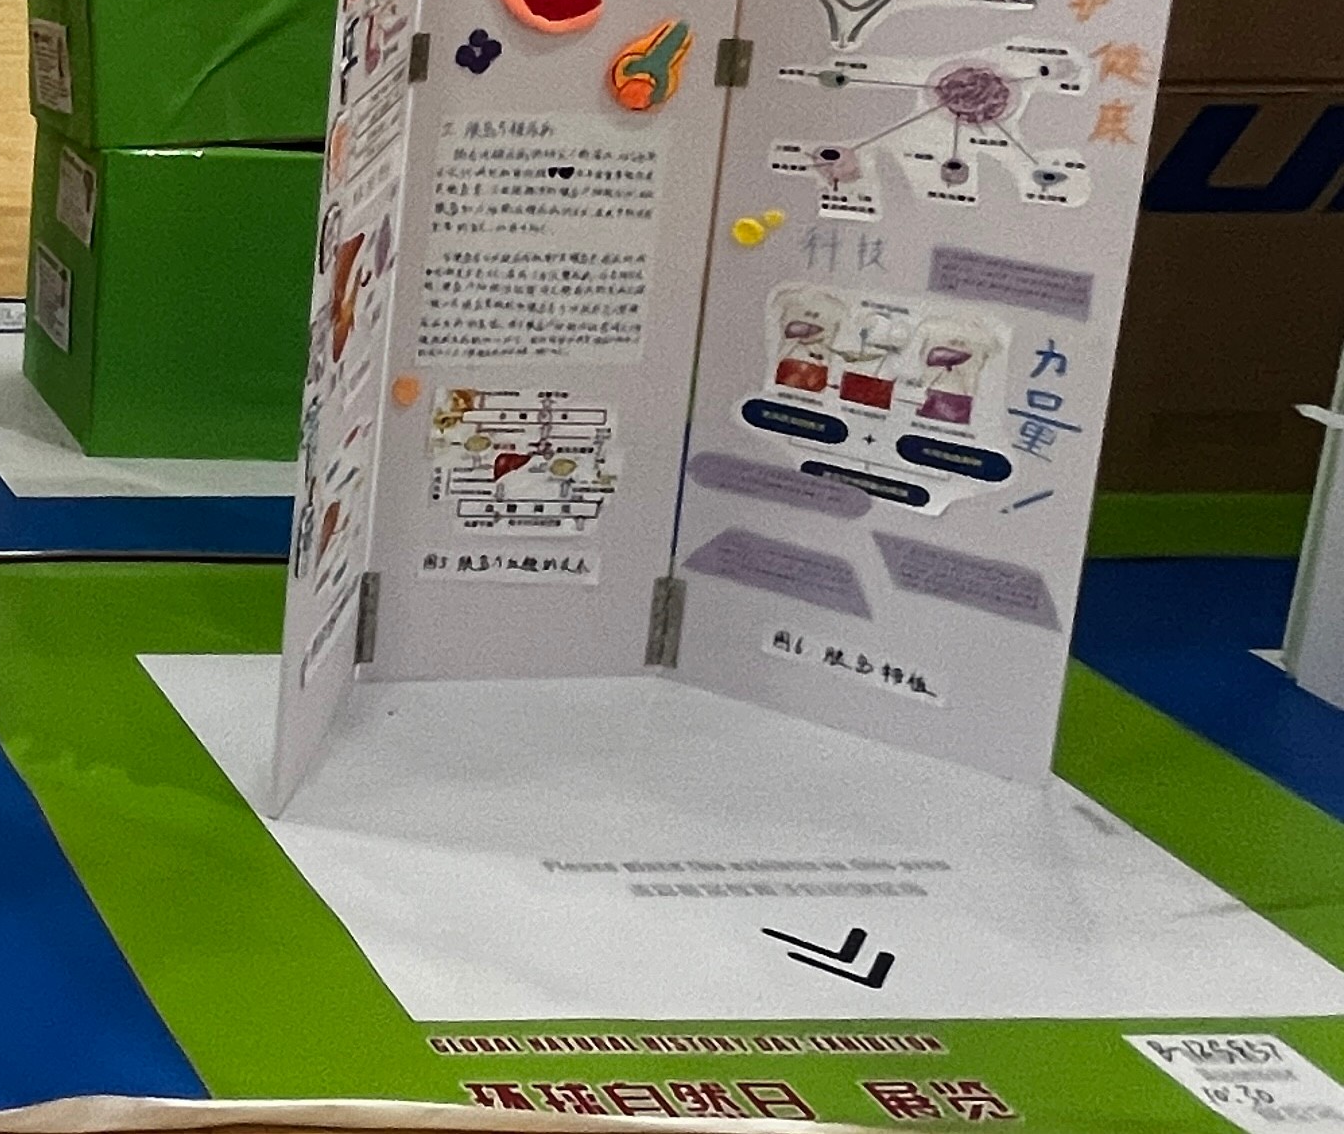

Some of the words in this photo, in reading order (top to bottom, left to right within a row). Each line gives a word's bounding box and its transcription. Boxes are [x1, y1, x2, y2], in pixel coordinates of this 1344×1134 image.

[427, 1036, 527, 1054] GLOBAL
[528, 1036, 643, 1054] NATURAL
[645, 1036, 754, 1054] HISTORY
[857, 1080, 1021, 1120] 展览
